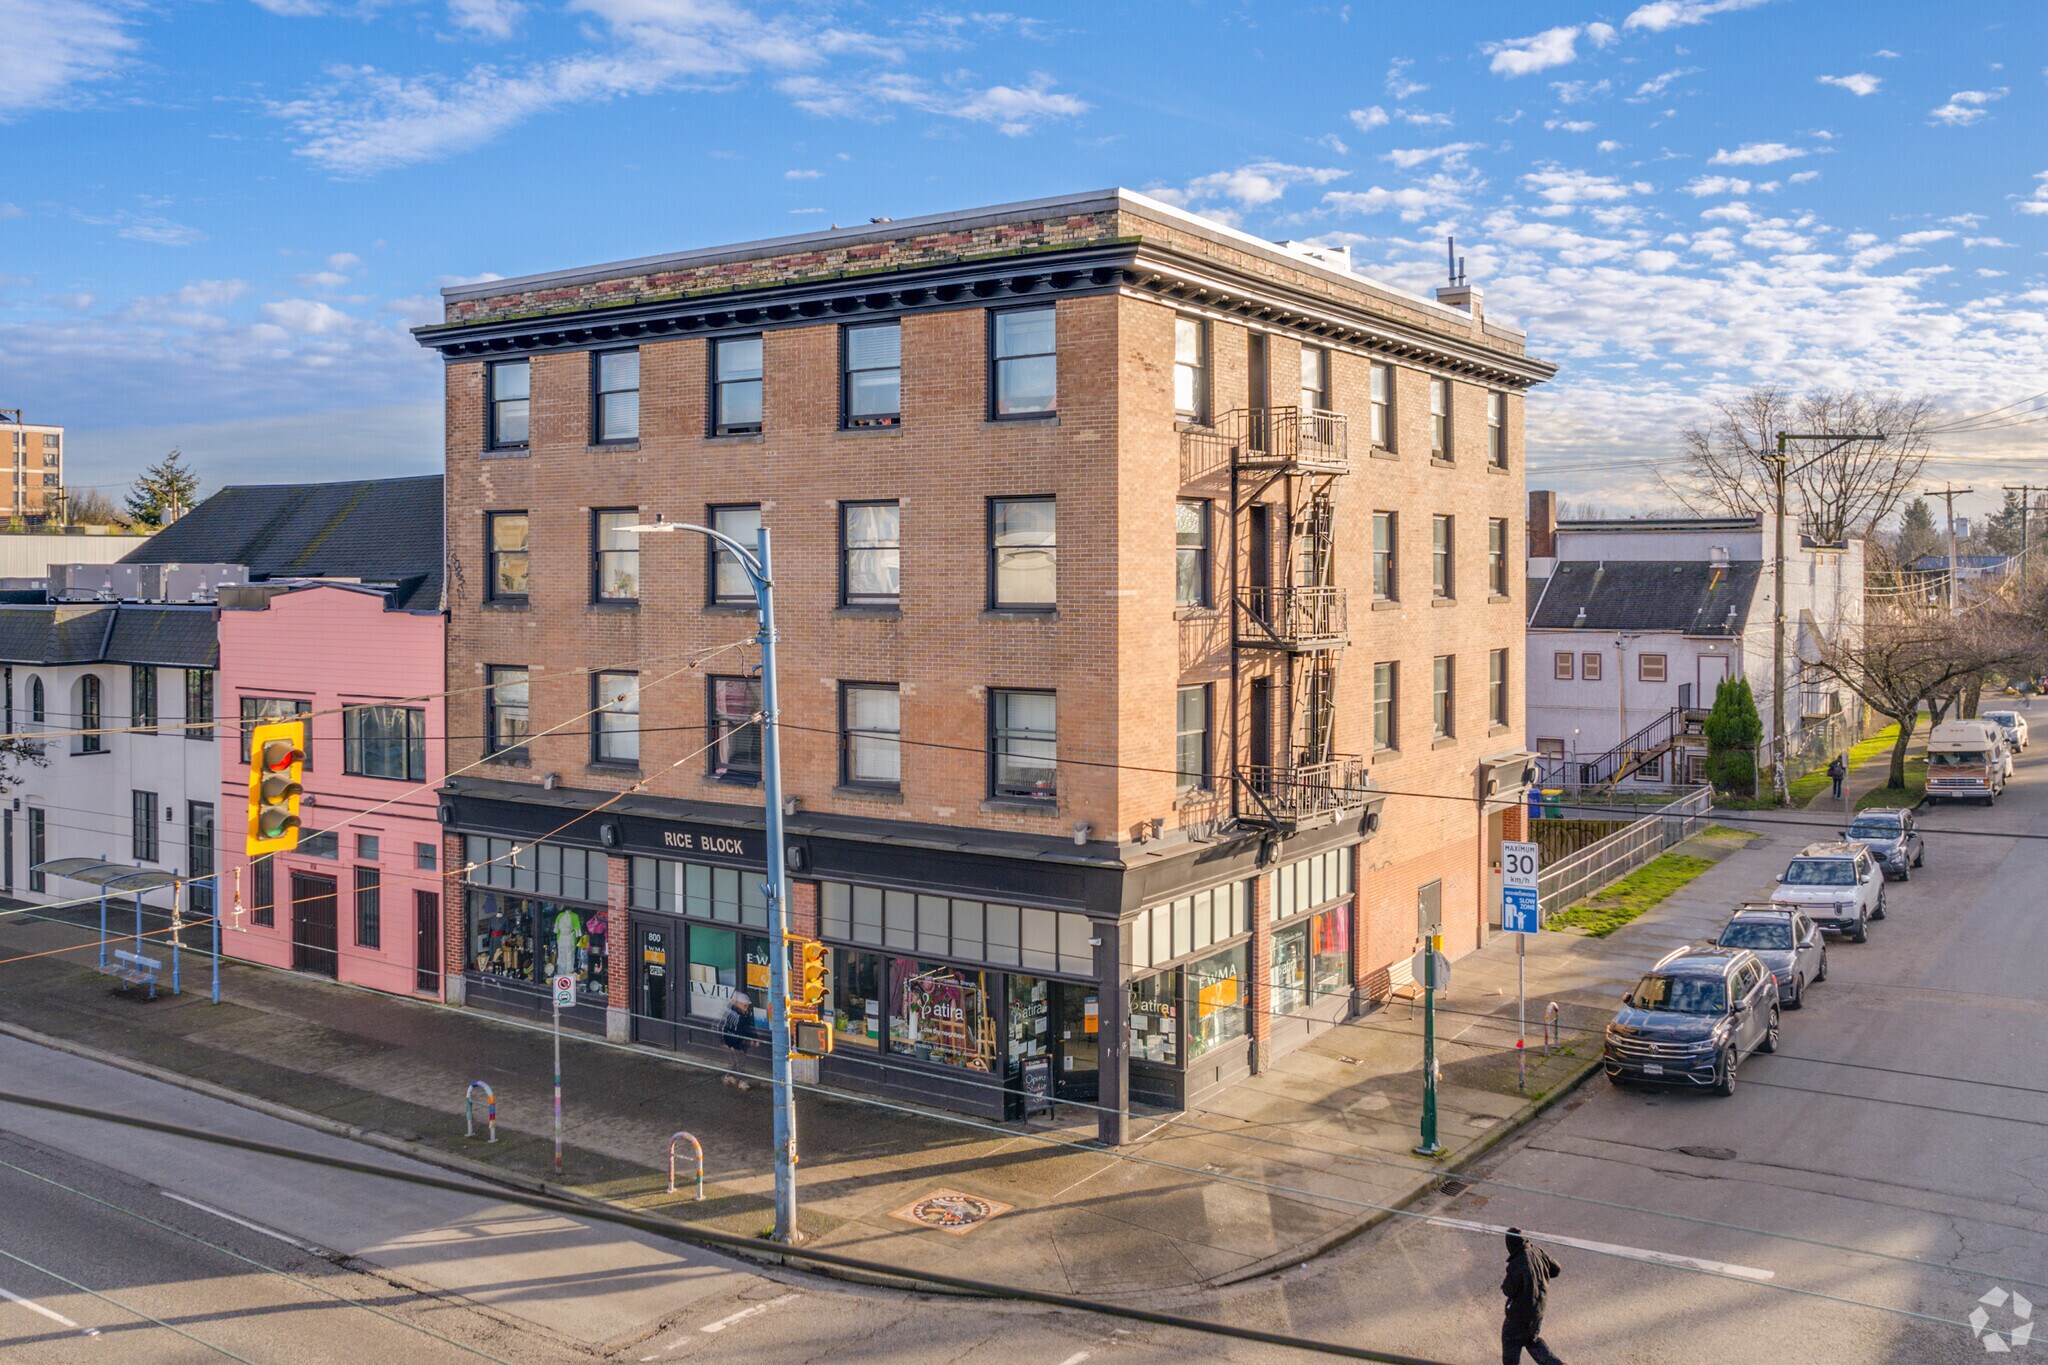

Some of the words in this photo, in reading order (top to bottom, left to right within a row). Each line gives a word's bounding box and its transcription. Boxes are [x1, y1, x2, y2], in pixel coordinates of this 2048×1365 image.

[664, 832, 693, 848] RICE
[701, 836, 743, 854] BLOCK
[1504, 845, 1535, 853] MAXIMUM
[1506, 854, 1534, 874] 30
[1510, 876, 1530, 884] km/h
[649, 933, 661, 942] 800
[1199, 964, 1237, 989] EWMA
[934, 1003, 964, 1021] atira
[1023, 1004, 1042, 1018] atira
[1141, 1000, 1169, 1014] atira
[818, 1029, 826, 1051] 5
[1025, 1074, 1047, 1085] Open
